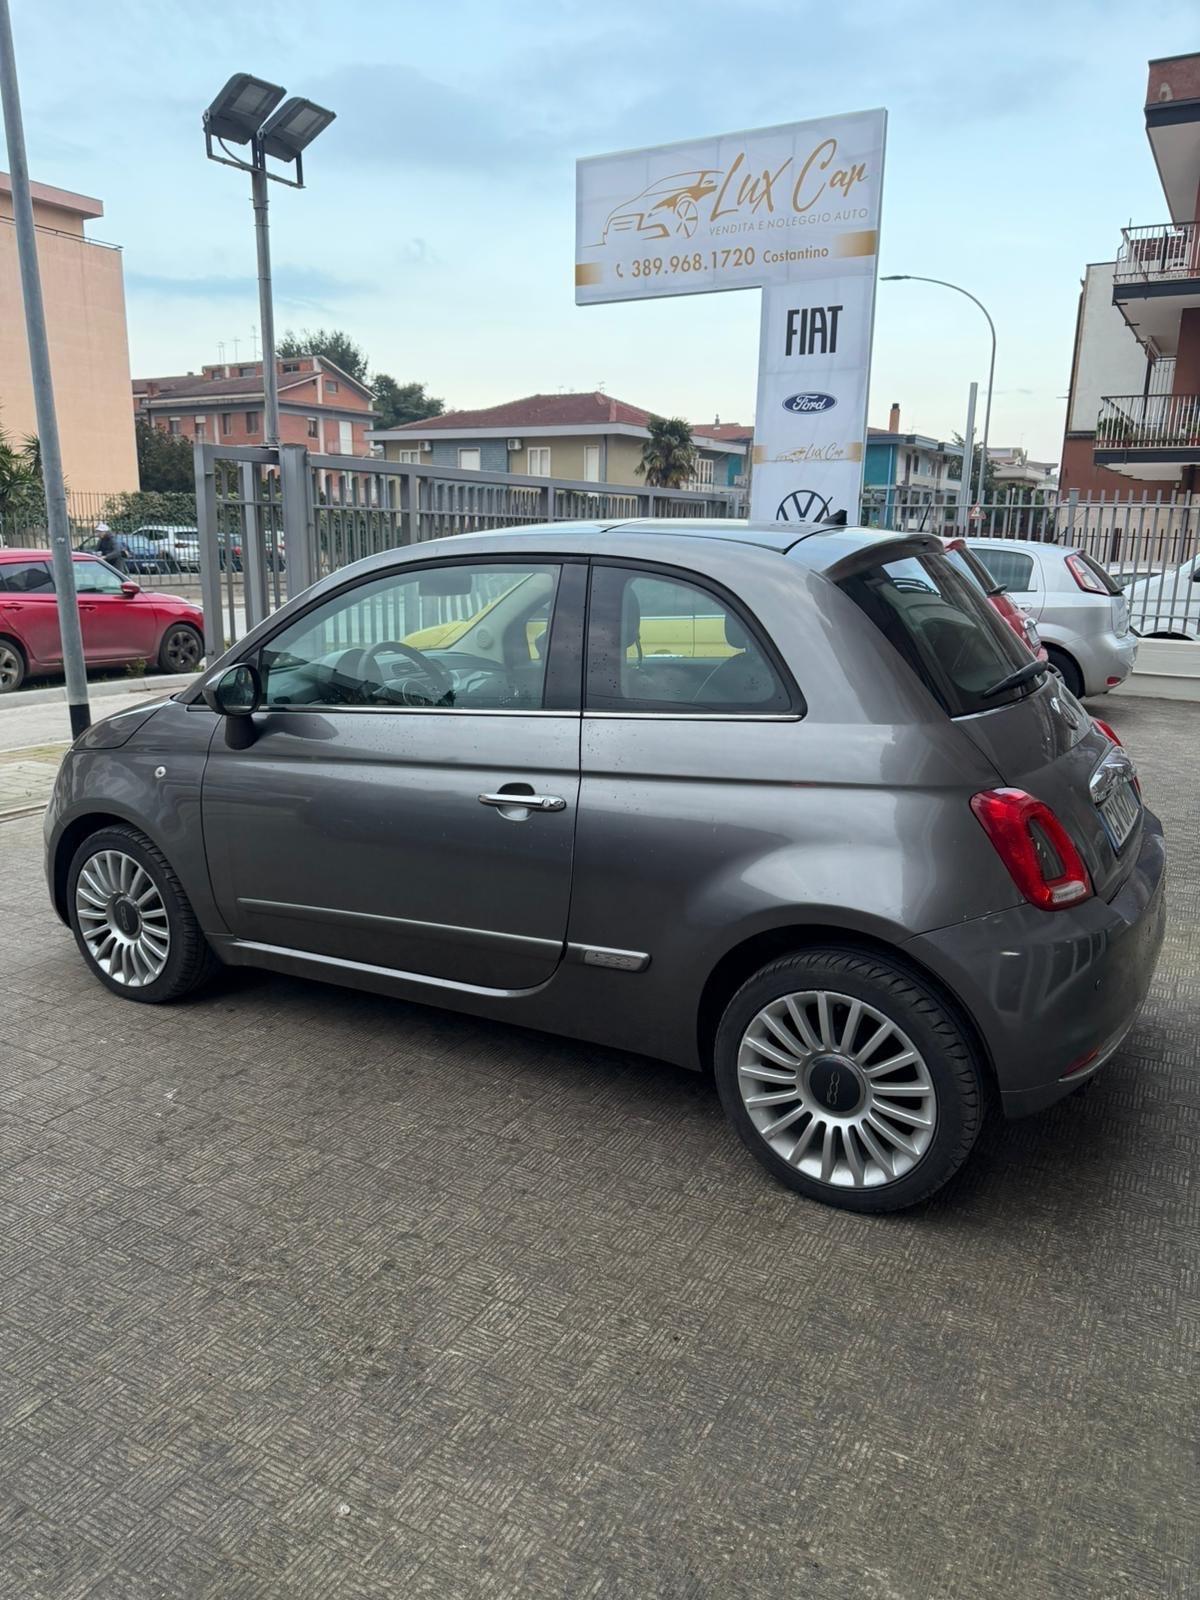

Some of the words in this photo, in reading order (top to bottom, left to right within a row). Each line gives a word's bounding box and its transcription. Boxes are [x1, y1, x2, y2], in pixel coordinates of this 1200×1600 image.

[709, 223, 755, 236] VENDITA
[758, 220, 765, 231] E
[767, 212, 832, 229] NOLEGGIO
[833, 207, 869, 221] AUTO
[631, 246, 756, 279] 389.968.1720
[762, 245, 830, 264] Costantino
[785, 305, 843, 356] FIAT
[792, 395, 828, 410] Ford
